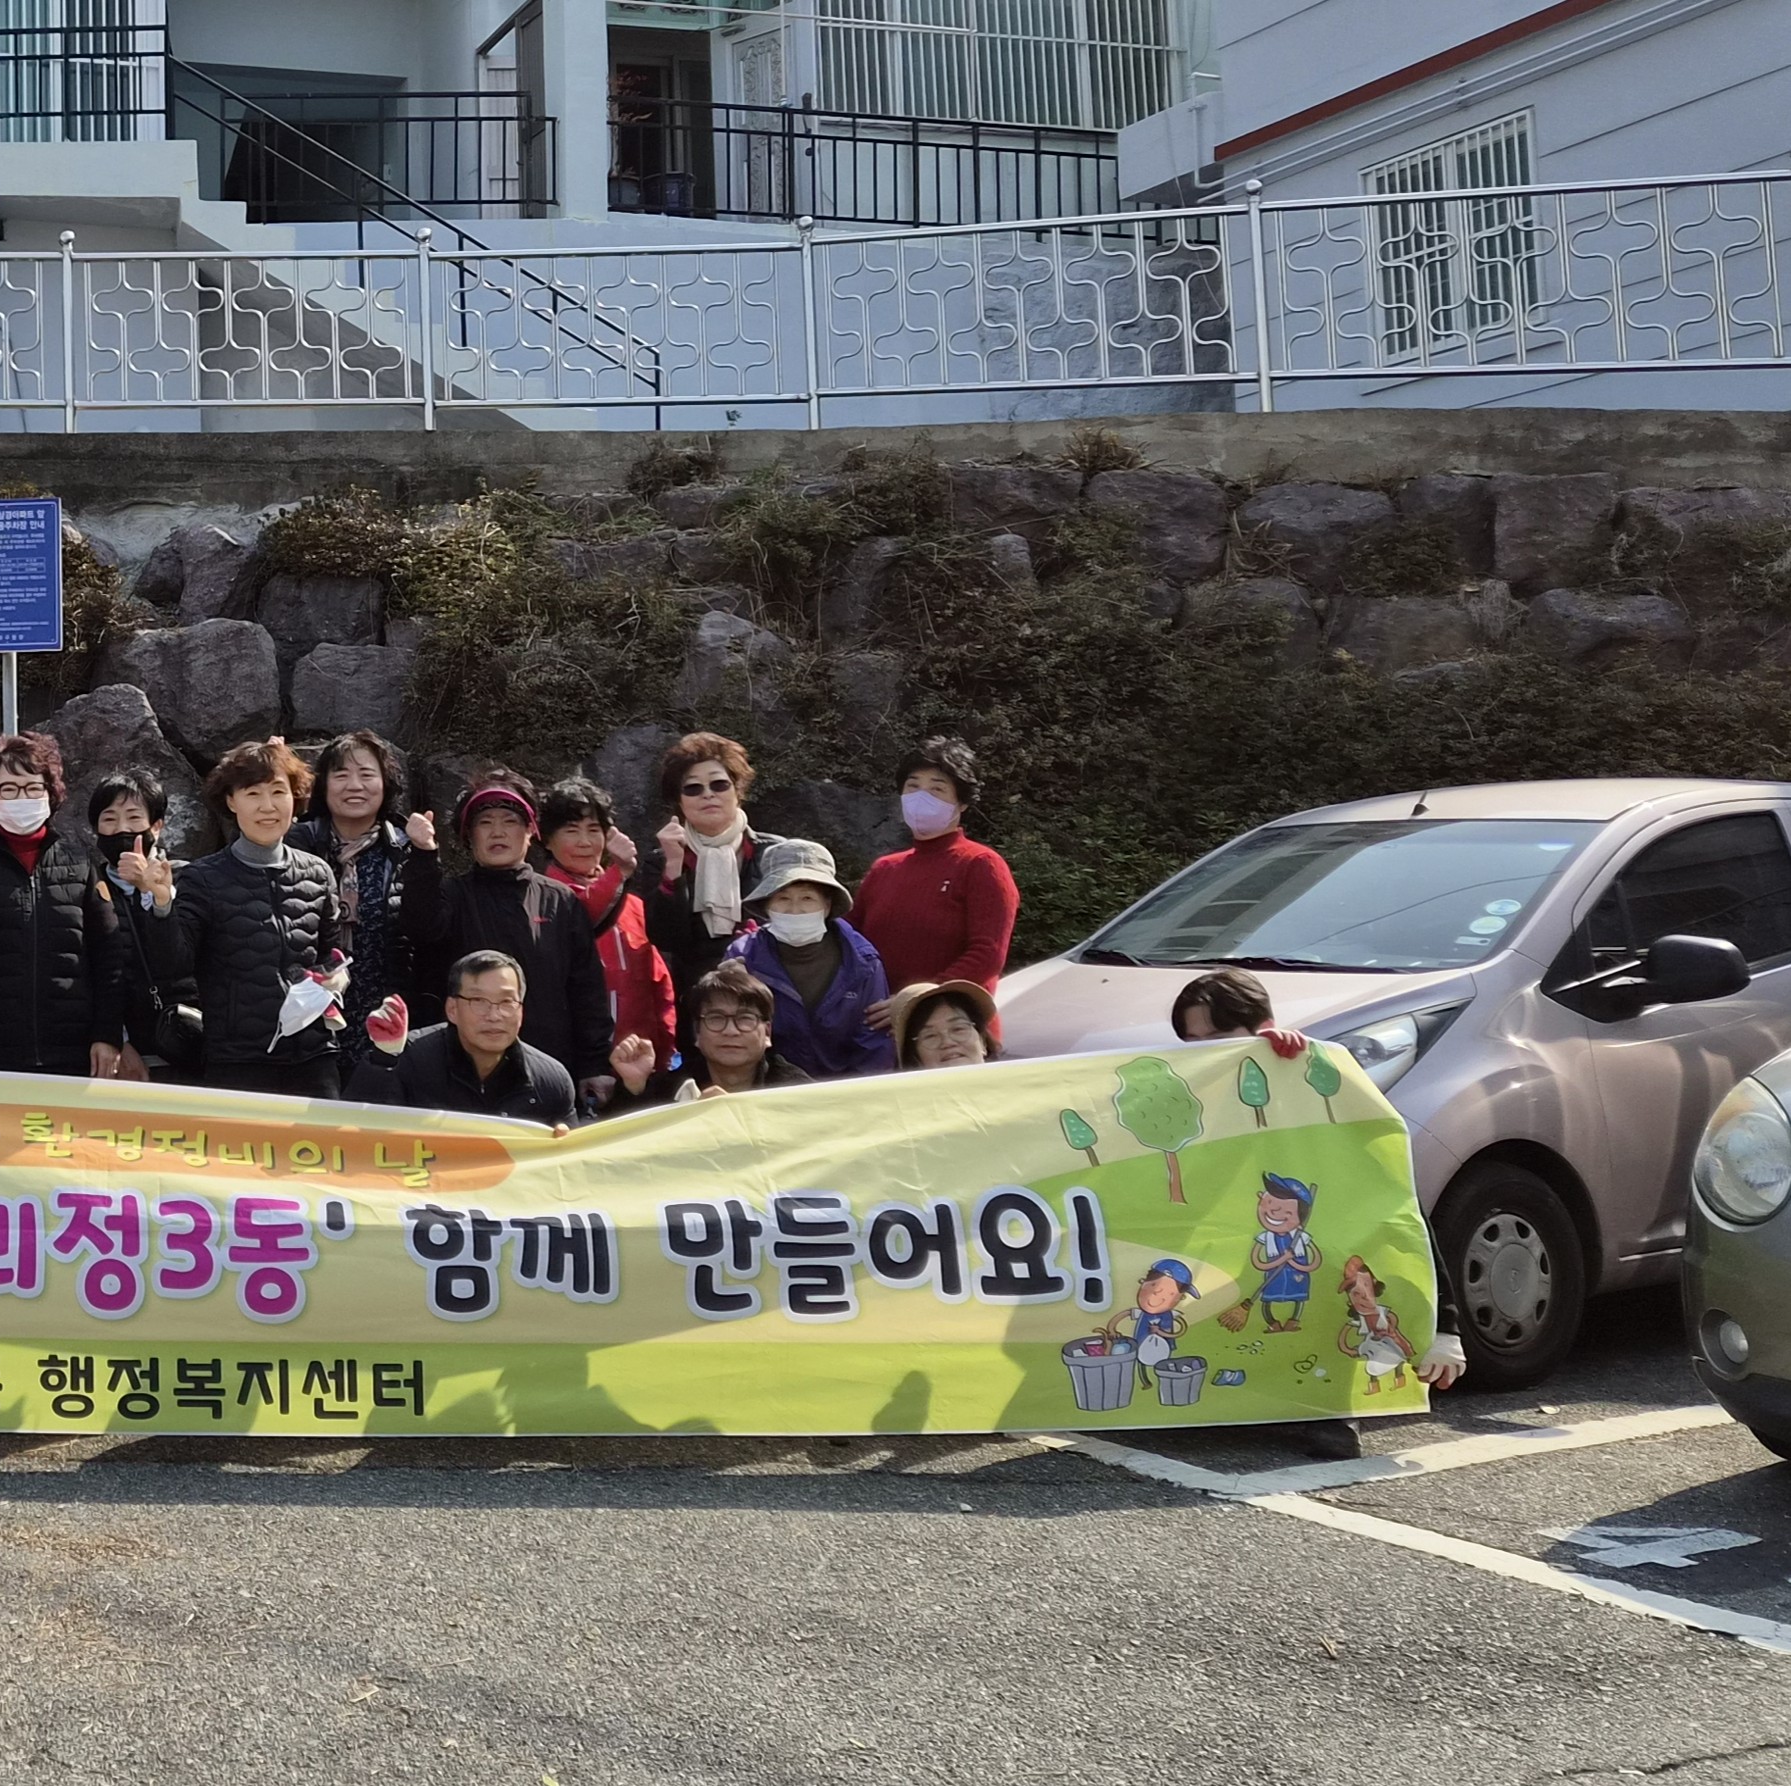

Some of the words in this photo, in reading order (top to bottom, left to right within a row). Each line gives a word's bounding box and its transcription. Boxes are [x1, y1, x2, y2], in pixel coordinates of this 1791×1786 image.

[20, 1111, 344, 1174] 환경정비의
[372, 1138, 436, 1188] 날
[410, 1202, 614, 1314] 함께
[662, 1190, 1106, 1316] 만들어요!
[37, 1353, 425, 1421] 행정복지센터
